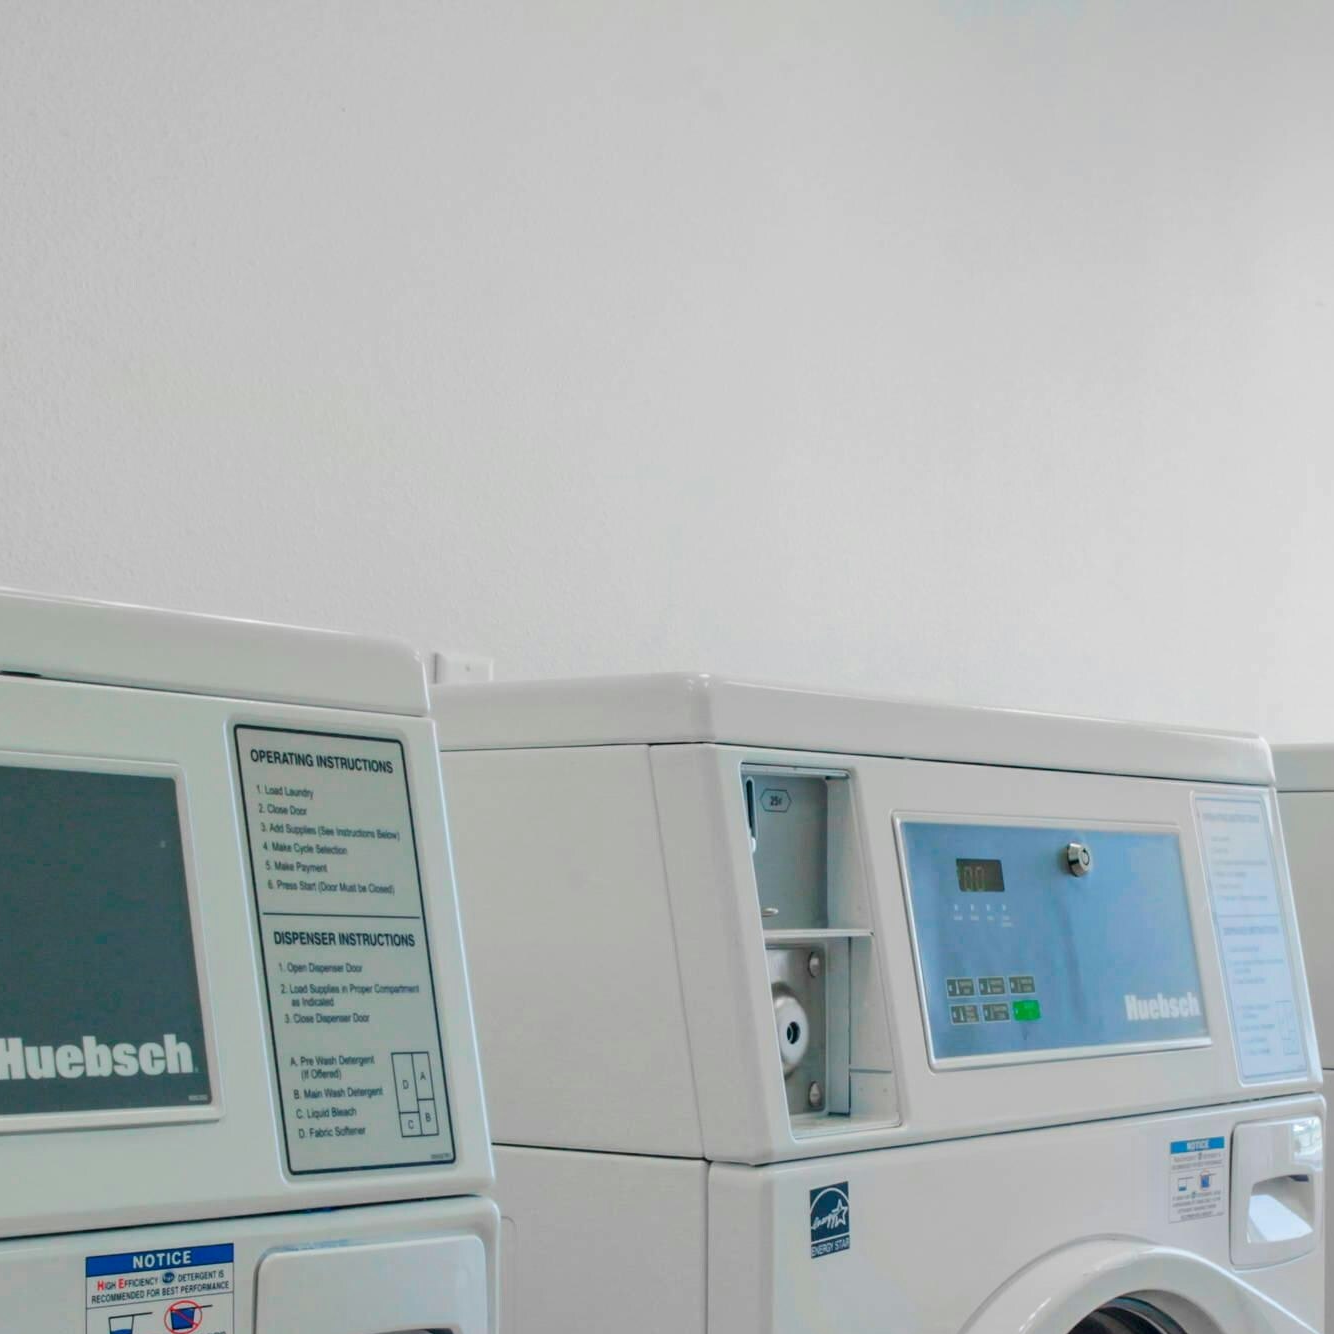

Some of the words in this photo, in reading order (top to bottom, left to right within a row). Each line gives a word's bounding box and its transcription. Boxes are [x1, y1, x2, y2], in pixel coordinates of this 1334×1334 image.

[250, 749, 314, 768] OPERATING
[316, 755, 394, 774] INSTRUCTIONS
[265, 785, 283, 796] Load
[285, 788, 315, 800] Laundry
[267, 804, 287, 815] Close
[289, 805, 307, 816] Door
[270, 823, 284, 833] Add
[285, 824, 316, 836] Supplies
[336, 828, 375, 839] Instructions
[272, 842, 292, 853] Make
[294, 843, 314, 855] Cycle
[316, 845, 348, 855] Selection
[275, 861, 294, 872] Make
[296, 862, 328, 874] Payment
[277, 881, 297, 891] Press
[340, 883, 357, 893] Must
[359, 884, 367, 893] be
[274, 931, 336, 946] DISPENSER
[339, 933, 416, 948] INSTRUCTIONS
[287, 963, 307, 974] Open
[309, 963, 344, 975] Dispenser
[345, 963, 363, 974] Door
[289, 985, 308, 995] Load
[309, 985, 340, 997] Supplies
[350, 985, 373, 997] Proper
[375, 985, 420, 997] Compartment
[302, 997, 335, 1008] Indicated
[1124, 991, 1202, 1021] Huebsch
[293, 1014, 315, 1024] Close
[316, 1013, 352, 1025] Dispenser
[353, 1013, 371, 1024] Door
[300, 1056, 314, 1067] Pre
[317, 1056, 337, 1067] Wash
[339, 1056, 375, 1068] Detergent
[418, 1071, 427, 1081] A
[402, 1080, 409, 1090] D
[304, 1089, 323, 1099] Main
[325, 1088, 345, 1099] Wash
[347, 1087, 384, 1100] Detergent
[307, 1109, 330, 1121] Liquid
[331, 1107, 356, 1118] Bleach
[424, 1112, 432, 1122] B
[408, 1119, 415, 1130] C
[309, 1127, 333, 1139] Fabric
[335, 1126, 366, 1138] Softener
[811, 1242, 834, 1258] ENERGY
[132, 1250, 192, 1269] NOTICE
[117, 1276, 158, 1290] EFFICIENCY
[178, 1270, 217, 1283] DETERGENT
[218, 1269, 225, 1279] IS
[91, 1289, 145, 1304] RECOMMENDED
[147, 1288, 160, 1298] FOR
[162, 1286, 178, 1296] BEST
[180, 1281, 229, 1294] PERFORMANCE
